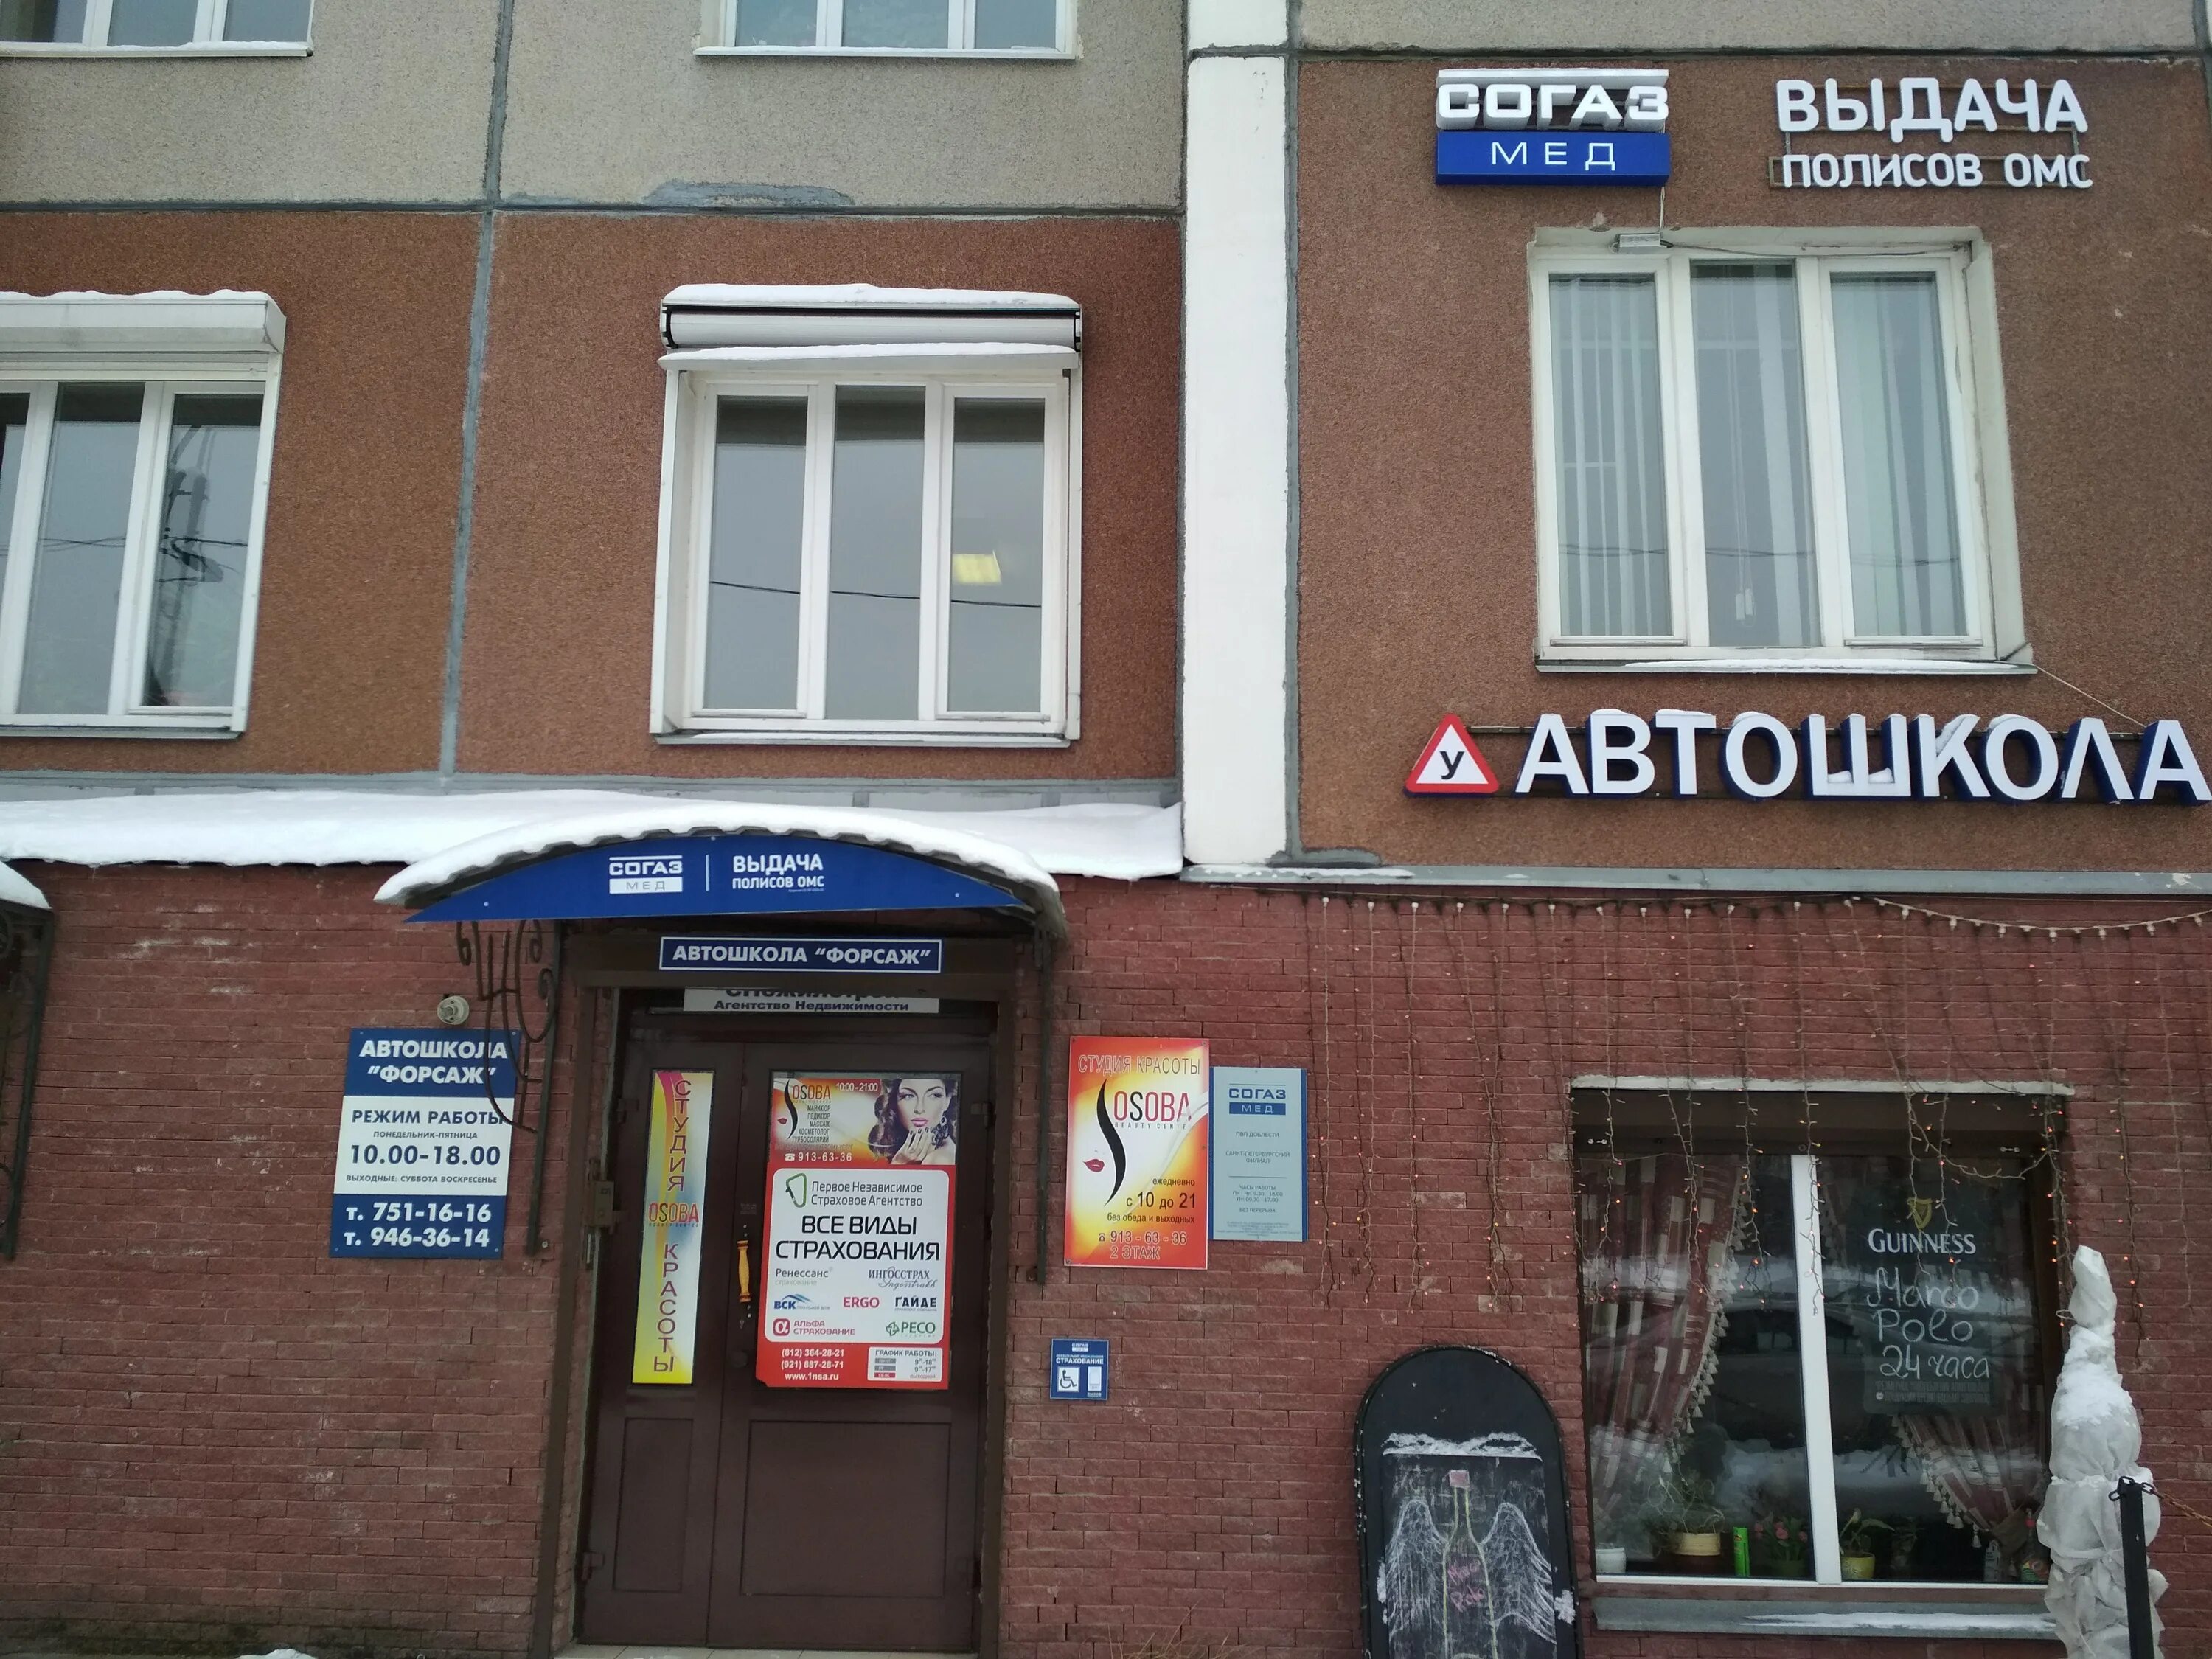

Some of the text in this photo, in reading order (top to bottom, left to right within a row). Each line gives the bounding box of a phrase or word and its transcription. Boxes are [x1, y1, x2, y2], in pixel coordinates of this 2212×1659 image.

[1437, 83, 1669, 128] СОГАЗ
[1778, 77, 2088, 144] ВЫДАЧА
[1491, 141, 1617, 172] МЕД
[1784, 153, 2093, 189] ПОЛИСОВ ОМС
[1514, 710, 2212, 802] АВТОШКОЛА
[609, 860, 683, 876] СОГАЗ
[733, 853, 824, 876] ВЫДАЧА
[626, 880, 666, 891] МЕД
[732, 875, 824, 889] ПОЛИСОВ ОМС
[672, 945, 808, 963] АВТОШКОЛА
[714, 1000, 909, 1012] Агентство Недвижимости
[358, 1040, 509, 1060] АВТОШКОЛА
[1078, 1054, 1201, 1077] СТУДИЯ КРАСОТЫ
[792, 1085, 831, 1100] OSOBA
[1229, 1088, 1286, 1099] СОГАЗ
[1113, 1091, 1192, 1121] OSOBA
[1242, 1105, 1273, 1114] МЕД
[351, 1110, 504, 1125] РЕЖИМ РАБОТЫ
[372, 1131, 479, 1140] ПОНЕДЕЛЬНИК-ПЯТНИЦА
[667, 1079, 692, 1192] СТУДИЯ
[350, 1144, 501, 1166] 10.00-18.00
[798, 1152, 852, 1162] 913-63-36
[811, 1180, 923, 1194] Первое Независимое
[1152, 1178, 1195, 1186] ежедневно
[811, 1194, 923, 1207] Страховое Агентство
[1137, 1191, 1154, 1208] 10
[1159, 1198, 1174, 1209] до
[1179, 1192, 1195, 1208] 21
[372, 1203, 492, 1222] 751-16-16
[648, 1202, 699, 1223] OSOBA
[1107, 1212, 1121, 1222] без
[1122, 1213, 1146, 1222] обеда
[1155, 1216, 1194, 1224] выходных
[801, 1215, 917, 1235] ВСЕ ВИДЫ
[370, 1227, 490, 1247] 946-36-14
[1110, 1230, 1132, 1243] 913
[1144, 1231, 1160, 1244] 63
[1172, 1232, 1186, 1245] 36
[1868, 1228, 1977, 1254] GUINNESS
[776, 1240, 940, 1261] СТРАХОВАНИЯ
[1110, 1245, 1160, 1259] 2 ЭТАЖ
[776, 1267, 829, 1278] Ренессанс
[869, 1267, 930, 1279] ИНГОССТРАХ
[653, 1243, 679, 1372] КРАСОТЫ
[774, 1301, 796, 1310] ВСК
[843, 1296, 880, 1308] ERGO
[894, 1295, 937, 1308] ГАЙДЕ
[793, 1320, 825, 1328] АЛЬФА
[793, 1327, 855, 1335] СТРАХОВАНИЕ
[901, 1321, 936, 1334] РЕСО
[782, 1349, 844, 1358] (812) 364-28-21
[781, 1360, 801, 1370] (921)
[1879, 1344, 1921, 1380] 24
[785, 1372, 839, 1380] www.1nsa.ru
